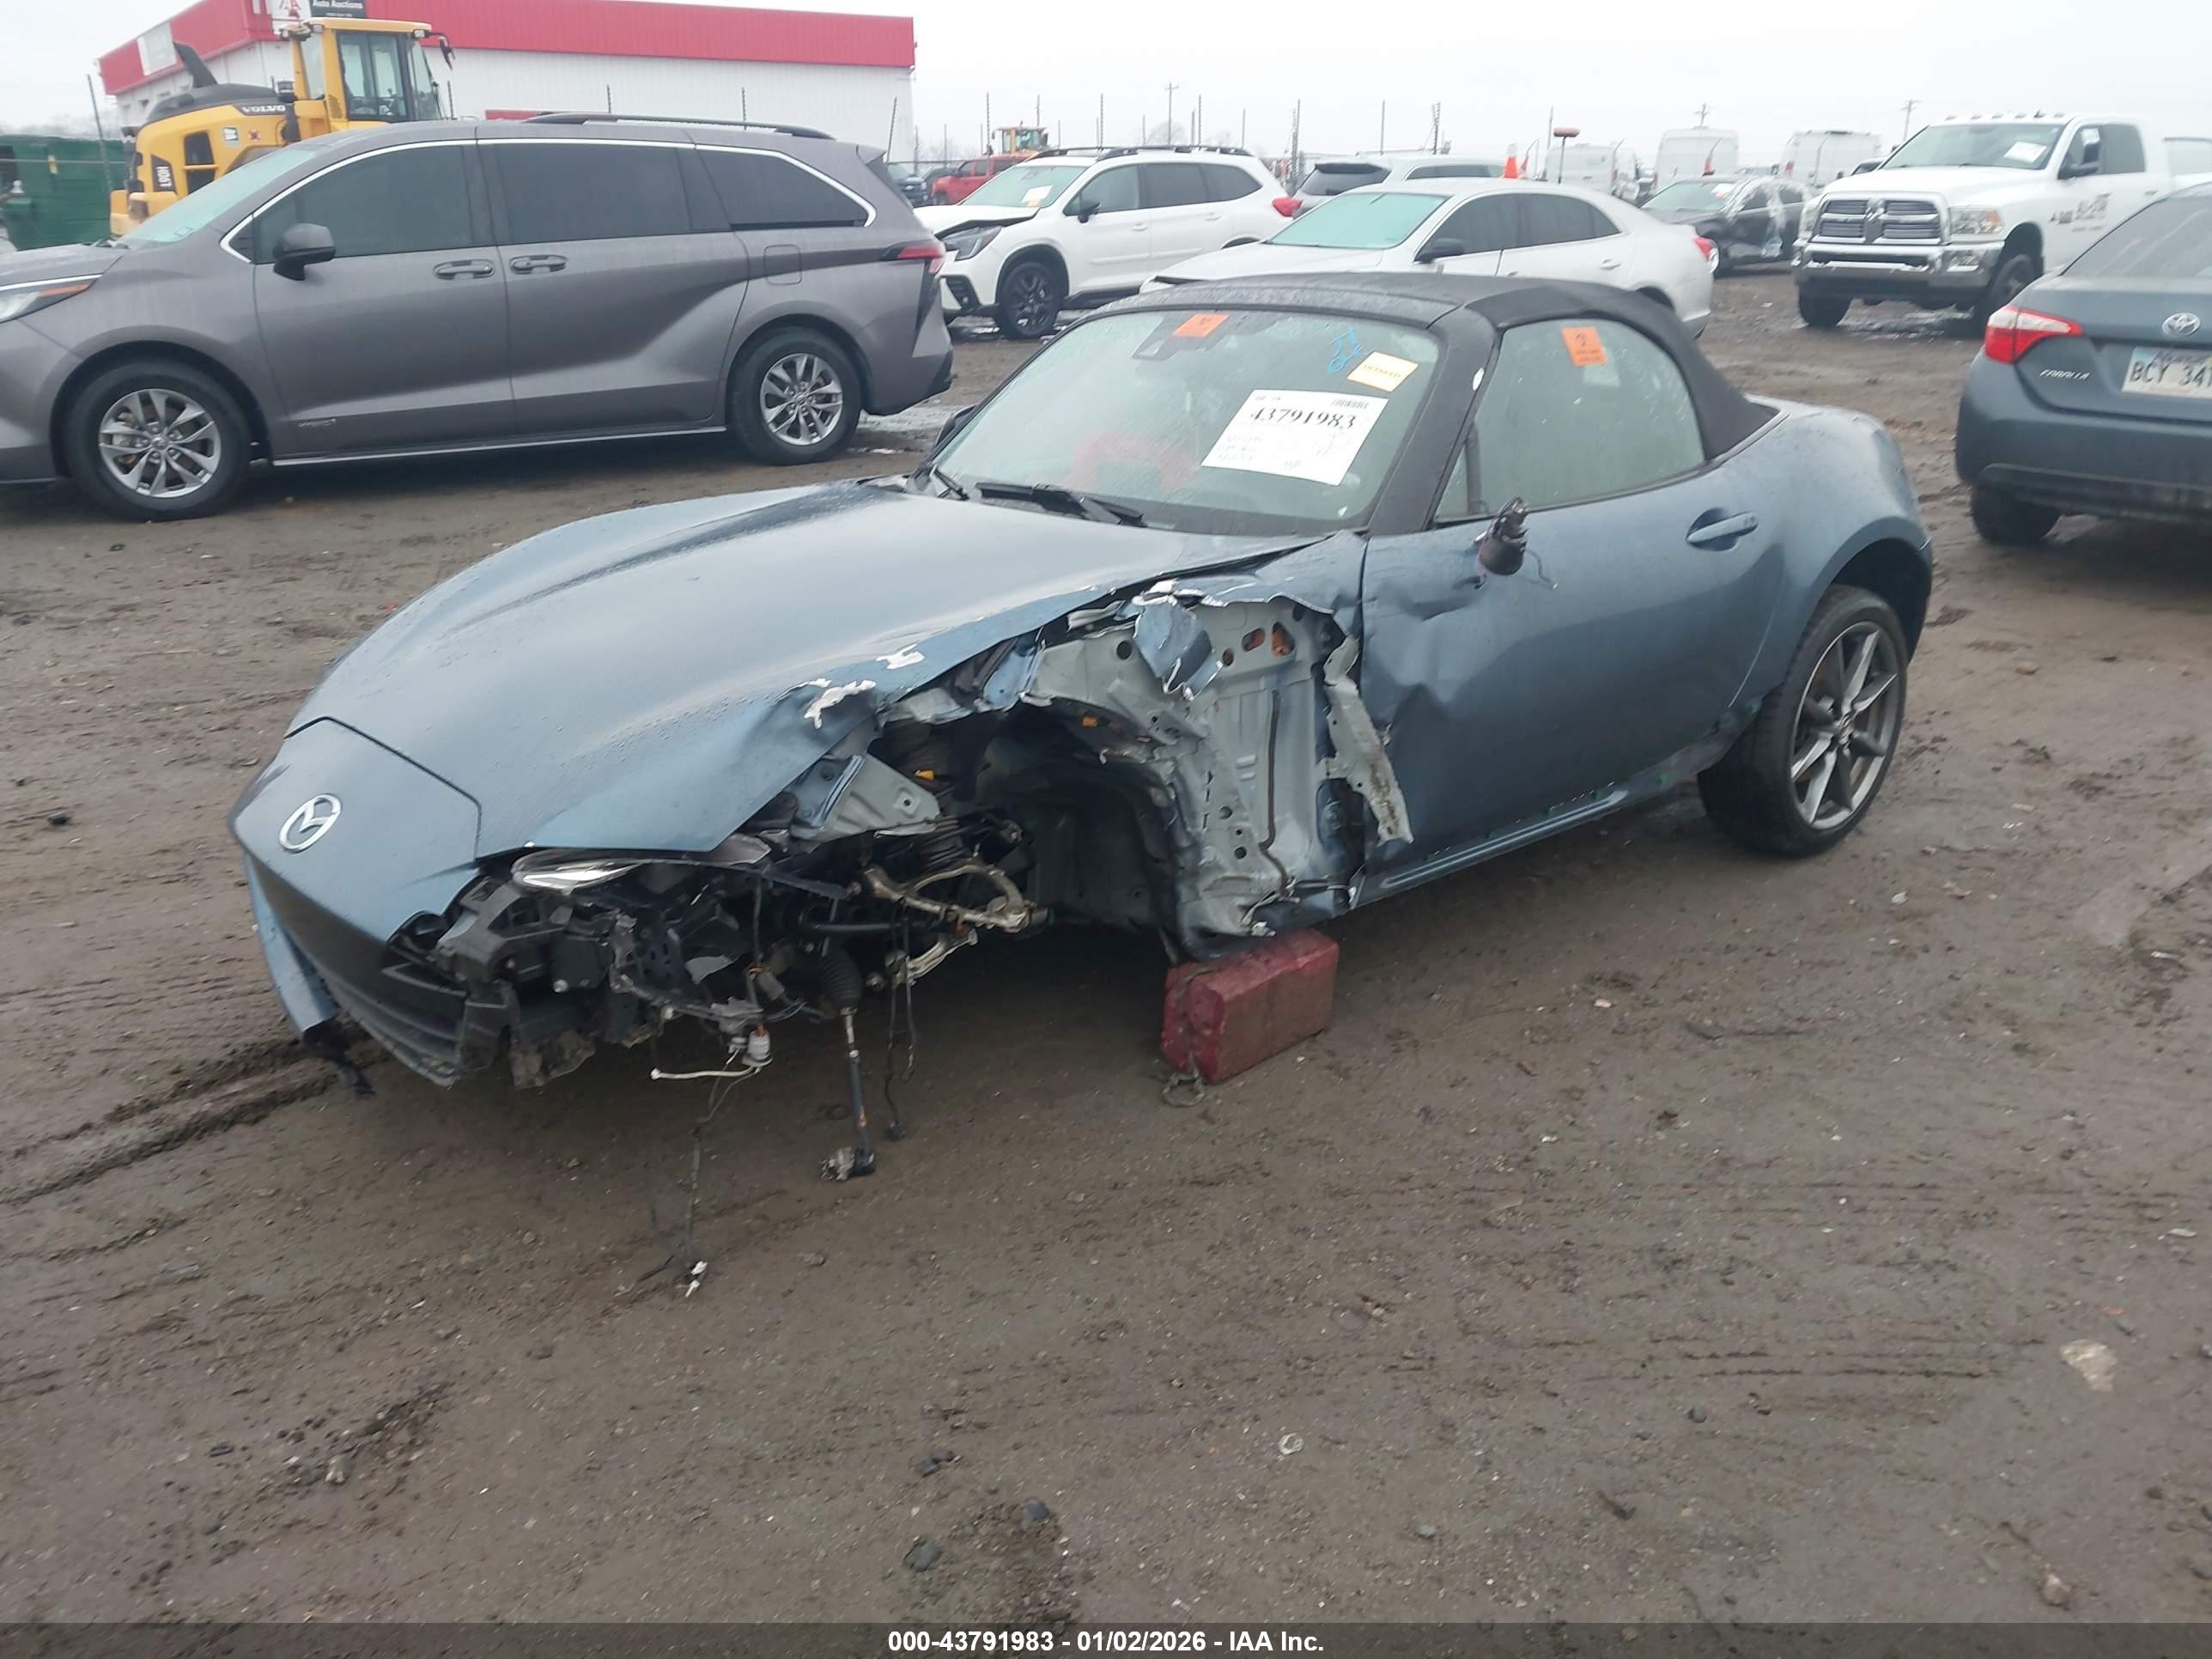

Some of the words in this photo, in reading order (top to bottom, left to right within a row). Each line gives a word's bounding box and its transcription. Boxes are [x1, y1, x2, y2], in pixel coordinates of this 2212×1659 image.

[241, 104, 286, 112] VOLVO
[2129, 360, 2171, 383] BCY
[1249, 407, 1357, 429] 43791983
